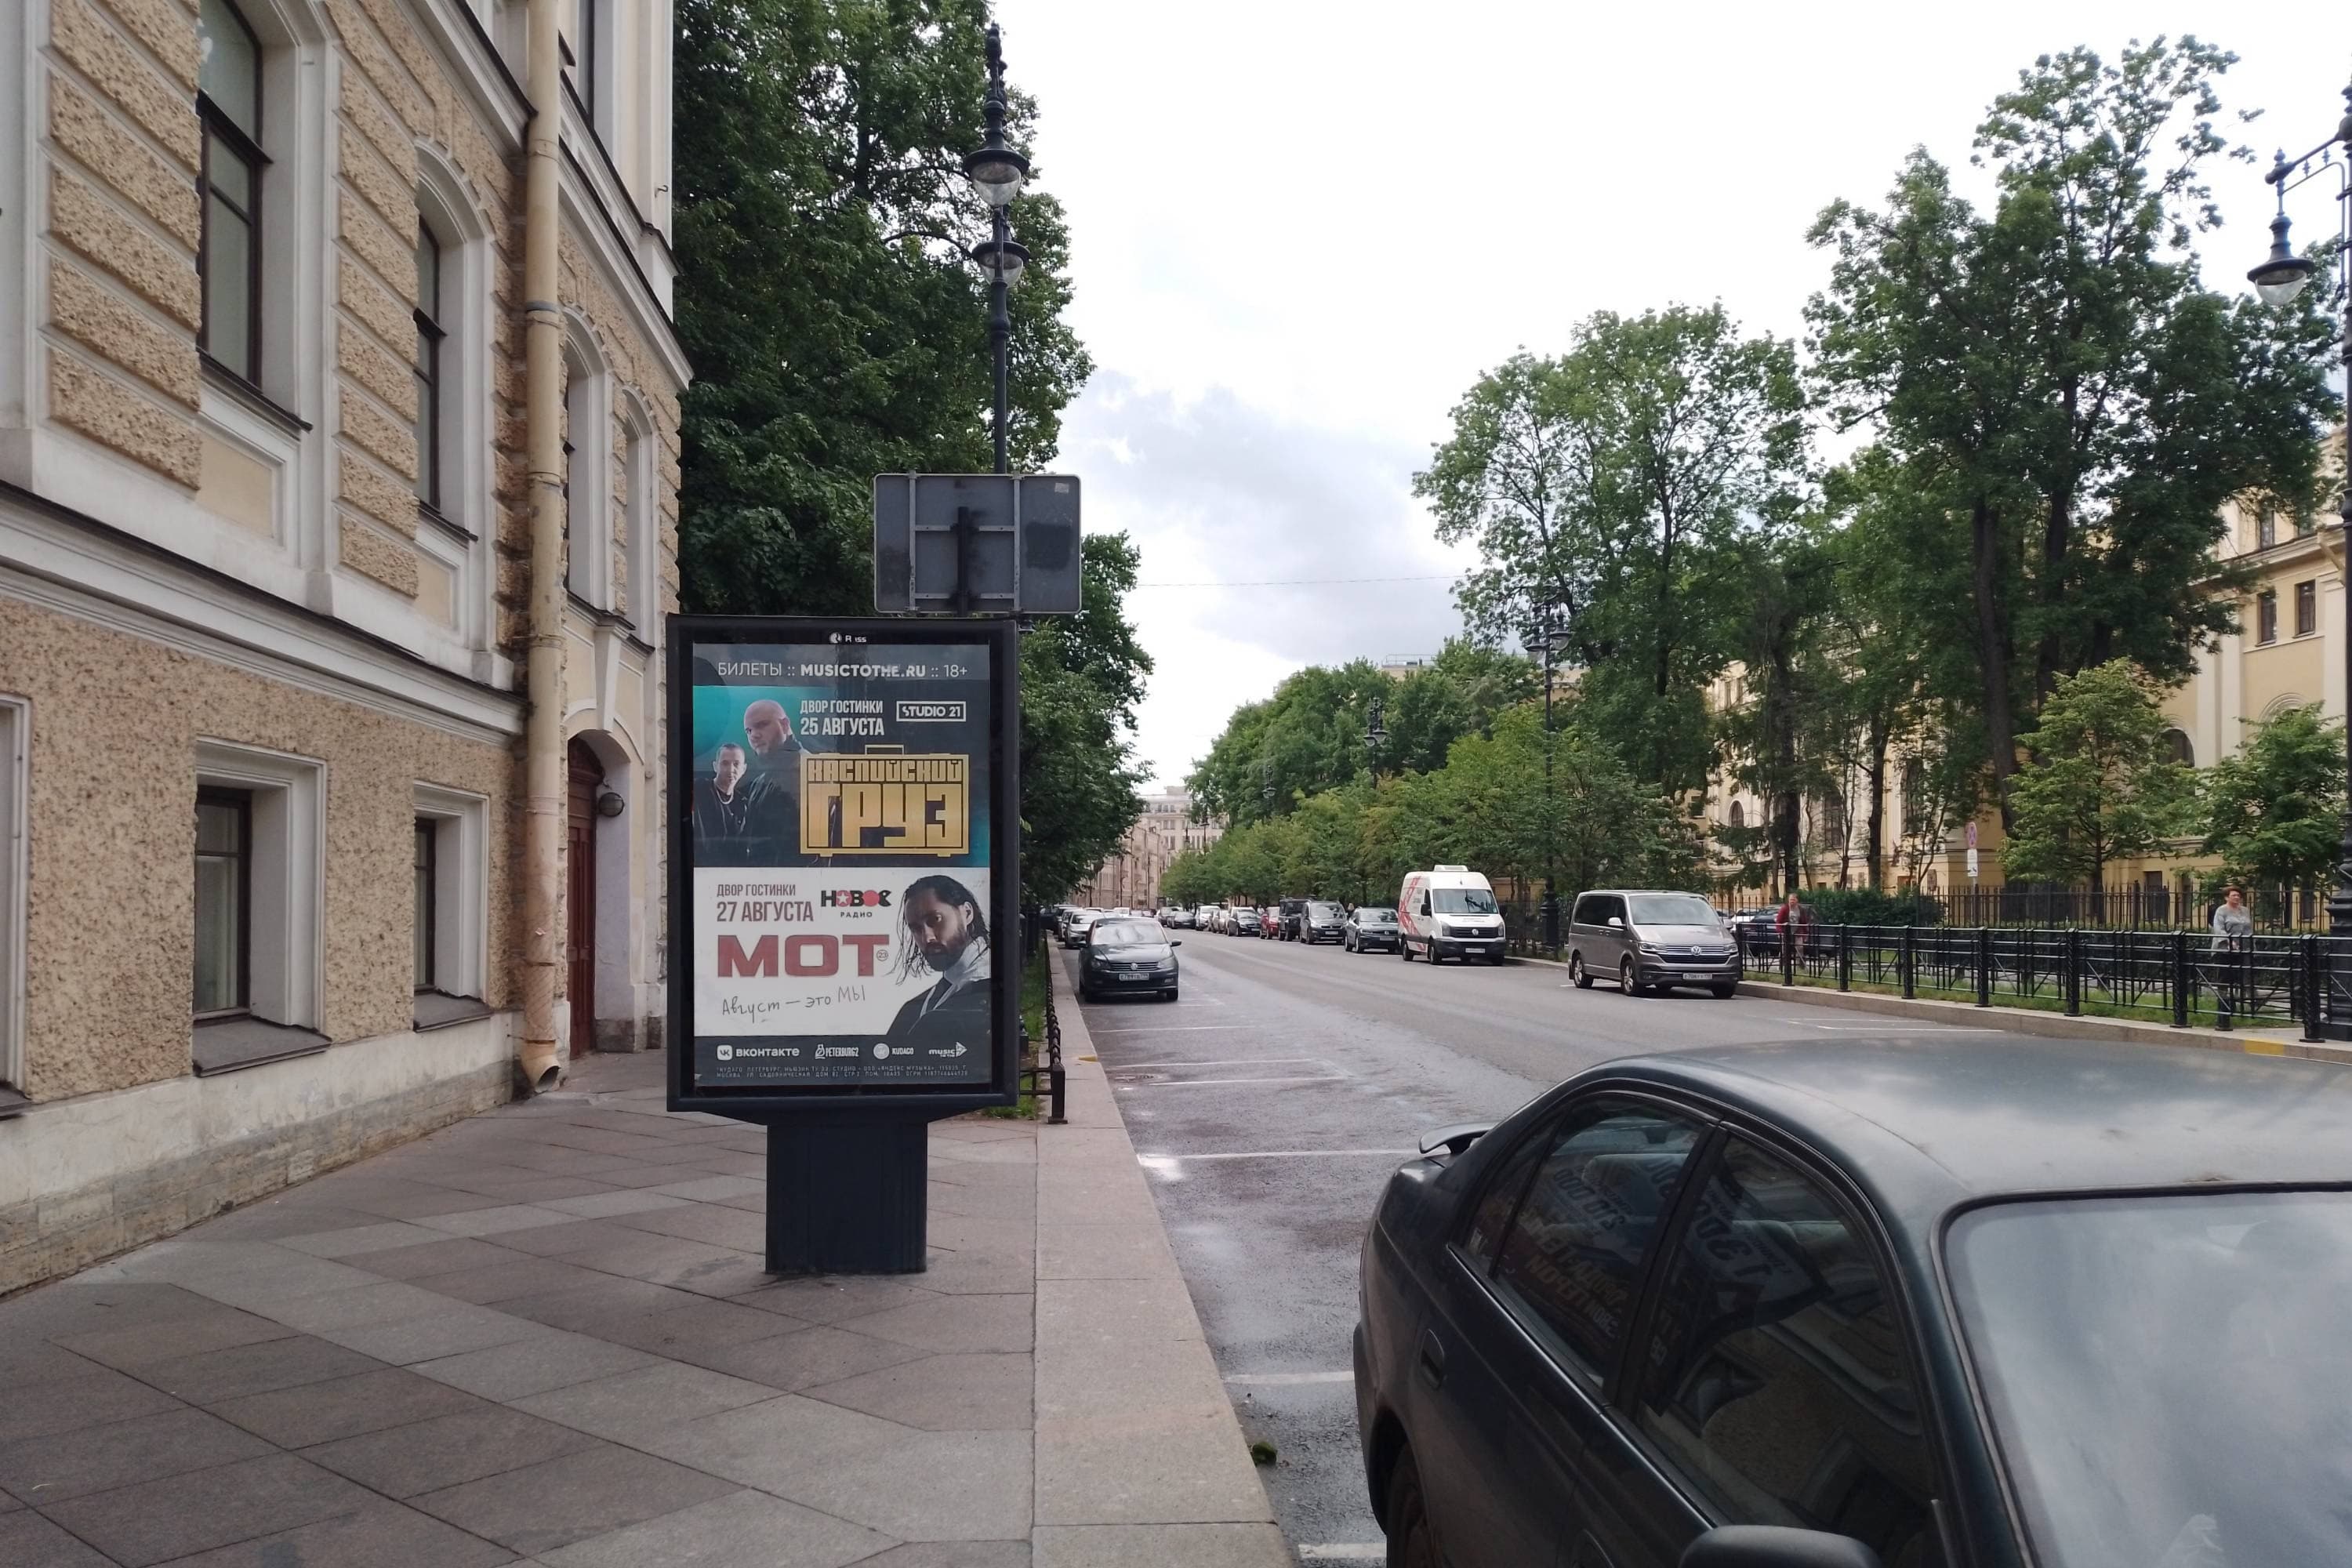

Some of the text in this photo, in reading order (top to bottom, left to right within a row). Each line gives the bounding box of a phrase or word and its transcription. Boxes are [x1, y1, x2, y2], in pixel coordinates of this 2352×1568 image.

[718, 662, 782, 677] БИЛЕТЫ
[800, 663, 926, 678] MUSICTOTHE.RU
[943, 665, 968, 678] 18+
[800, 700, 884, 714] ДВОР ГОСТИНКИ
[902, 706, 961, 717] STUDIO 21
[800, 717, 885, 736] 25 АВГУСТА
[807, 758, 962, 782] КАСПИЙСКИЙ
[807, 783, 964, 848] ГРУЗ
[717, 884, 796, 897] ДВОР ГОСТИНКИ
[717, 901, 814, 922] 27 АВГУСТА
[717, 934, 890, 978] МОТ
[721, 996, 781, 1024] Август
[805, 995, 832, 1009] это
